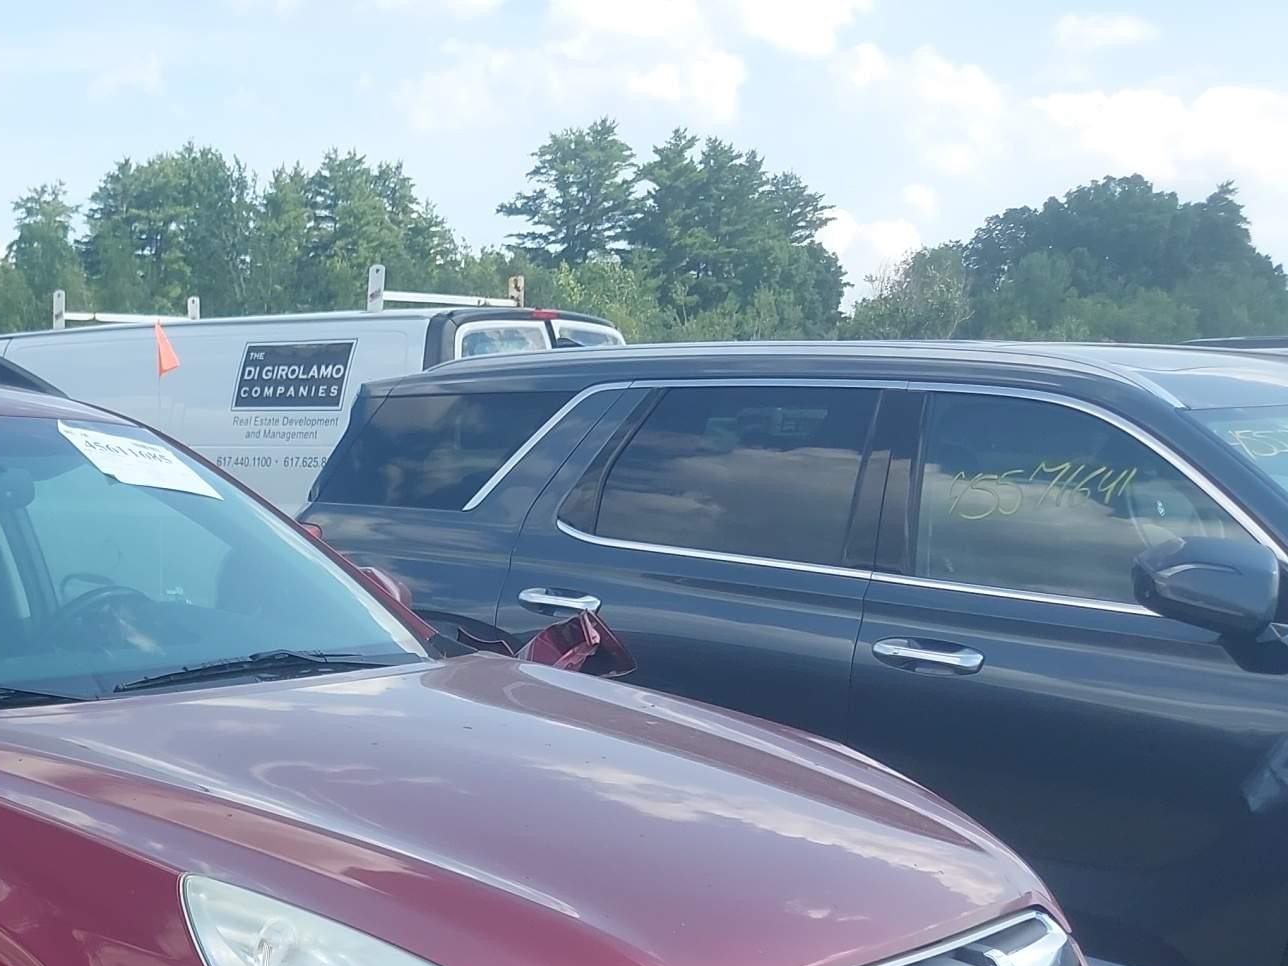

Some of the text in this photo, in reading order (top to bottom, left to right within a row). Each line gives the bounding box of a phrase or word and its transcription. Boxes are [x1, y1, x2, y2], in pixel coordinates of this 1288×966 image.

[249, 352, 265, 360] THE
[243, 364, 345, 380] DI GIROLAMO
[240, 385, 339, 398] COMPANIES
[232, 416, 339, 429] Real Estate Development
[245, 430, 318, 442] and Management
[216, 456, 329, 468] 617.440.1100 617.625.8
